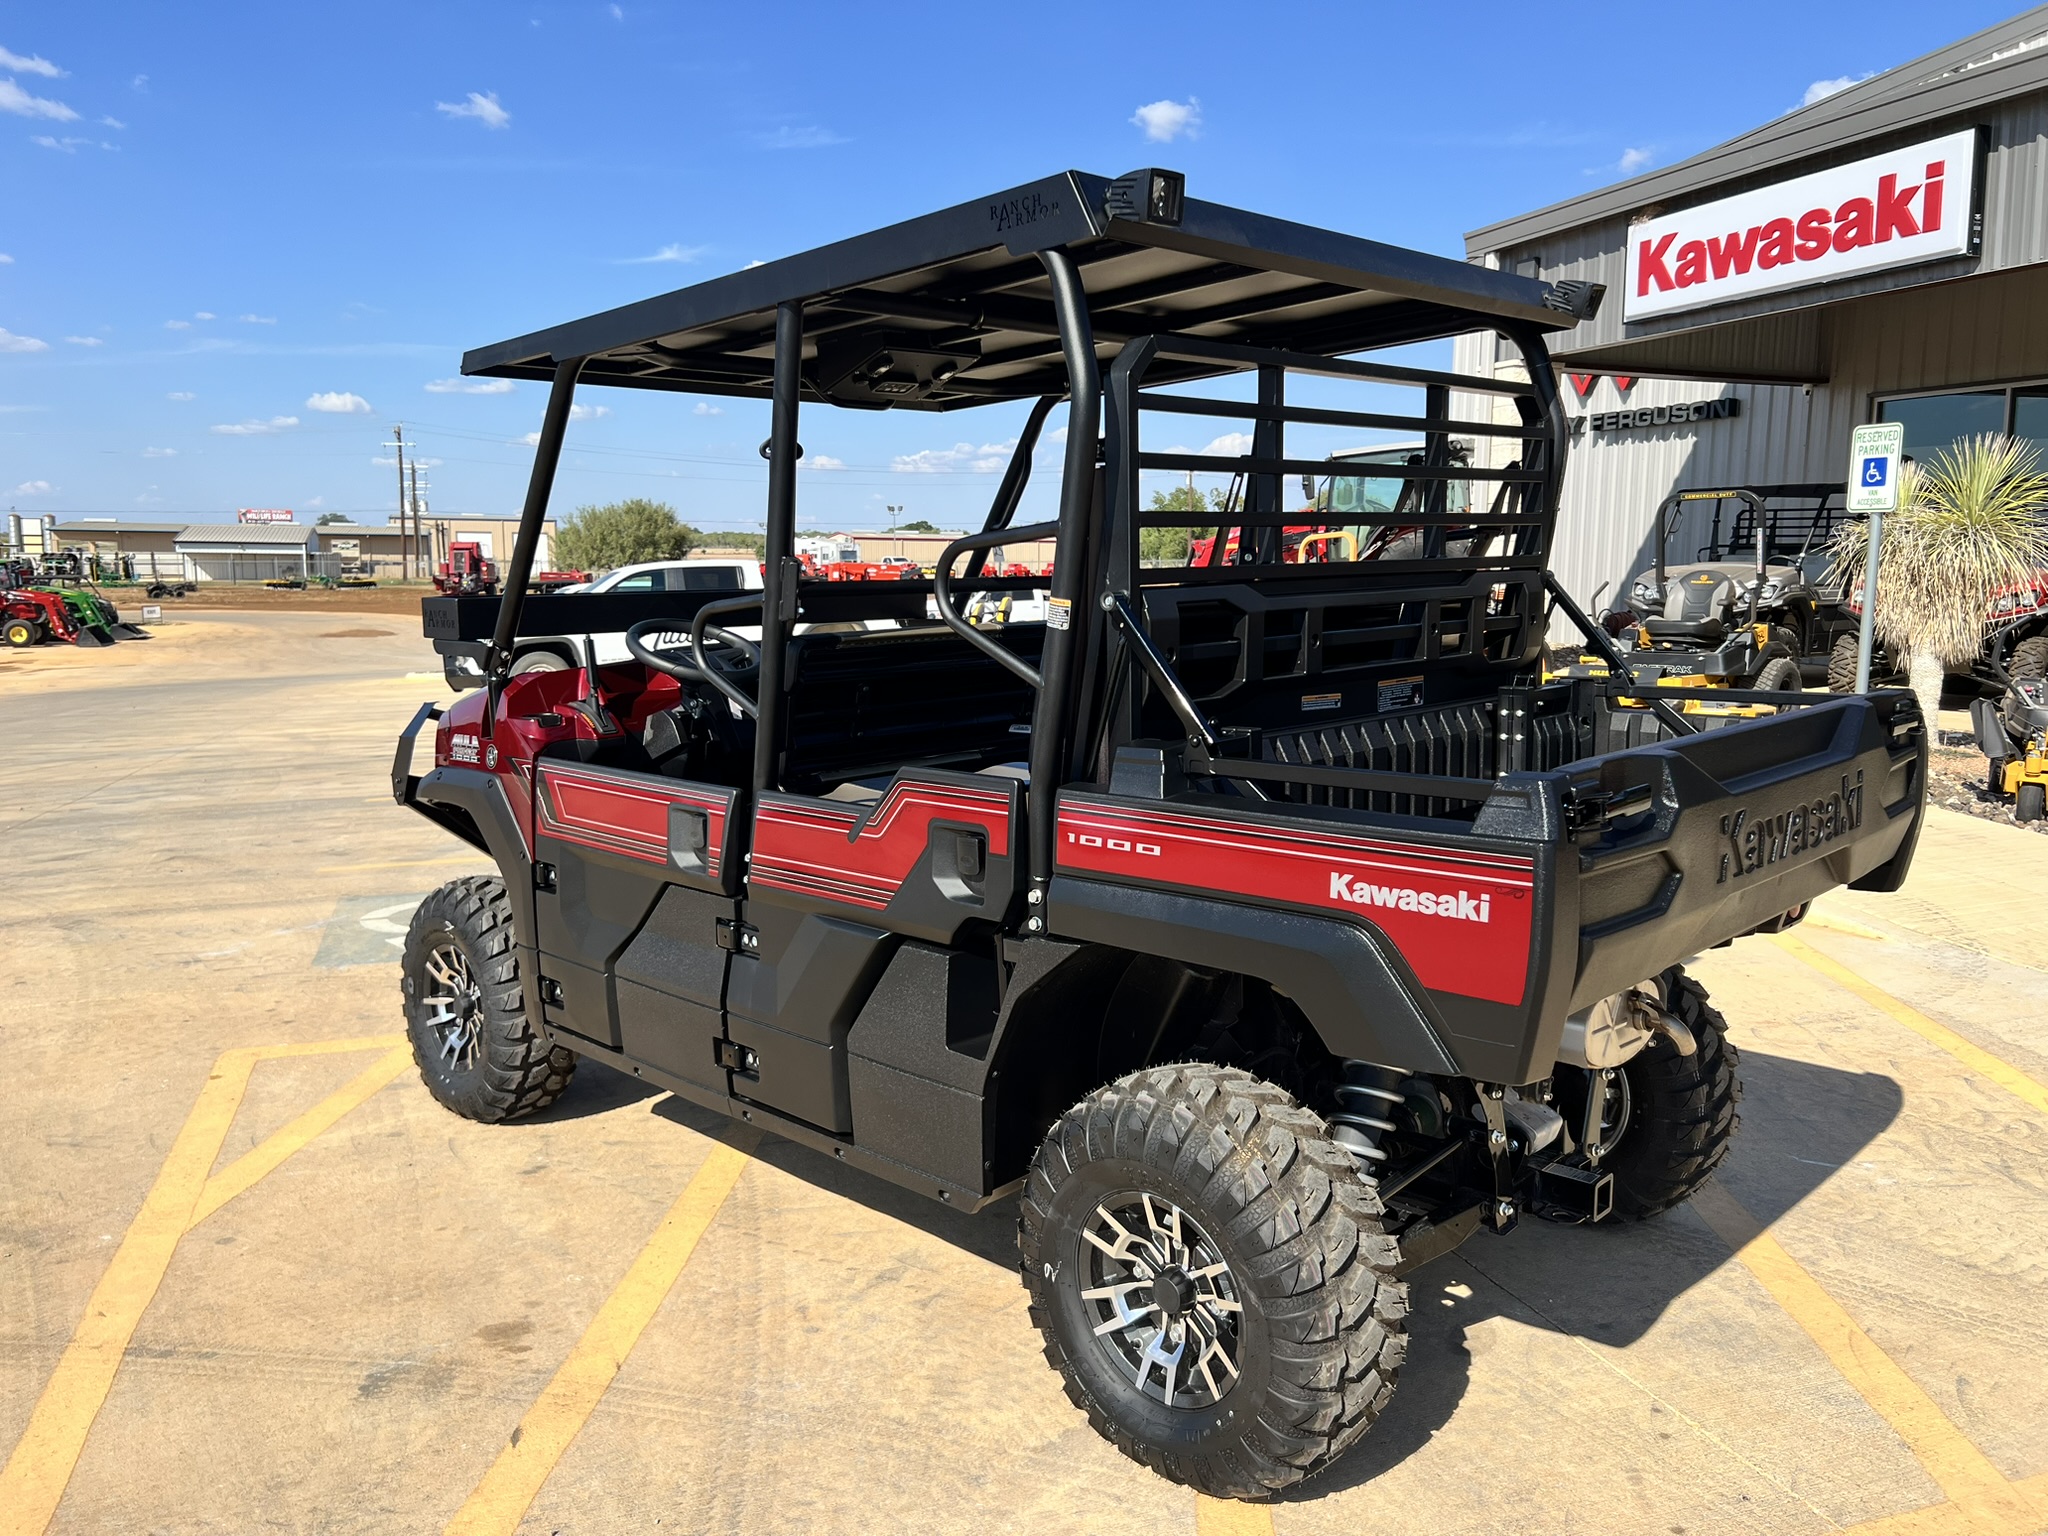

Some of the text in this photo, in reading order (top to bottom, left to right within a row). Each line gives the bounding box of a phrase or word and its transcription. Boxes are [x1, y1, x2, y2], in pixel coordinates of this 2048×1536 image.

[990, 193, 1041, 220] RANCH
[997, 201, 1060, 232] ARMOR
[1636, 158, 1946, 297] Kawasaki
[1590, 398, 1740, 432] FERGUSON
[1856, 430, 1899, 443] RESERVED
[1857, 443, 1895, 456] PARKING
[1717, 768, 1863, 884] Kawasaki
[1067, 832, 1161, 856] 1000
[1329, 871, 1490, 923] Kawasaki
